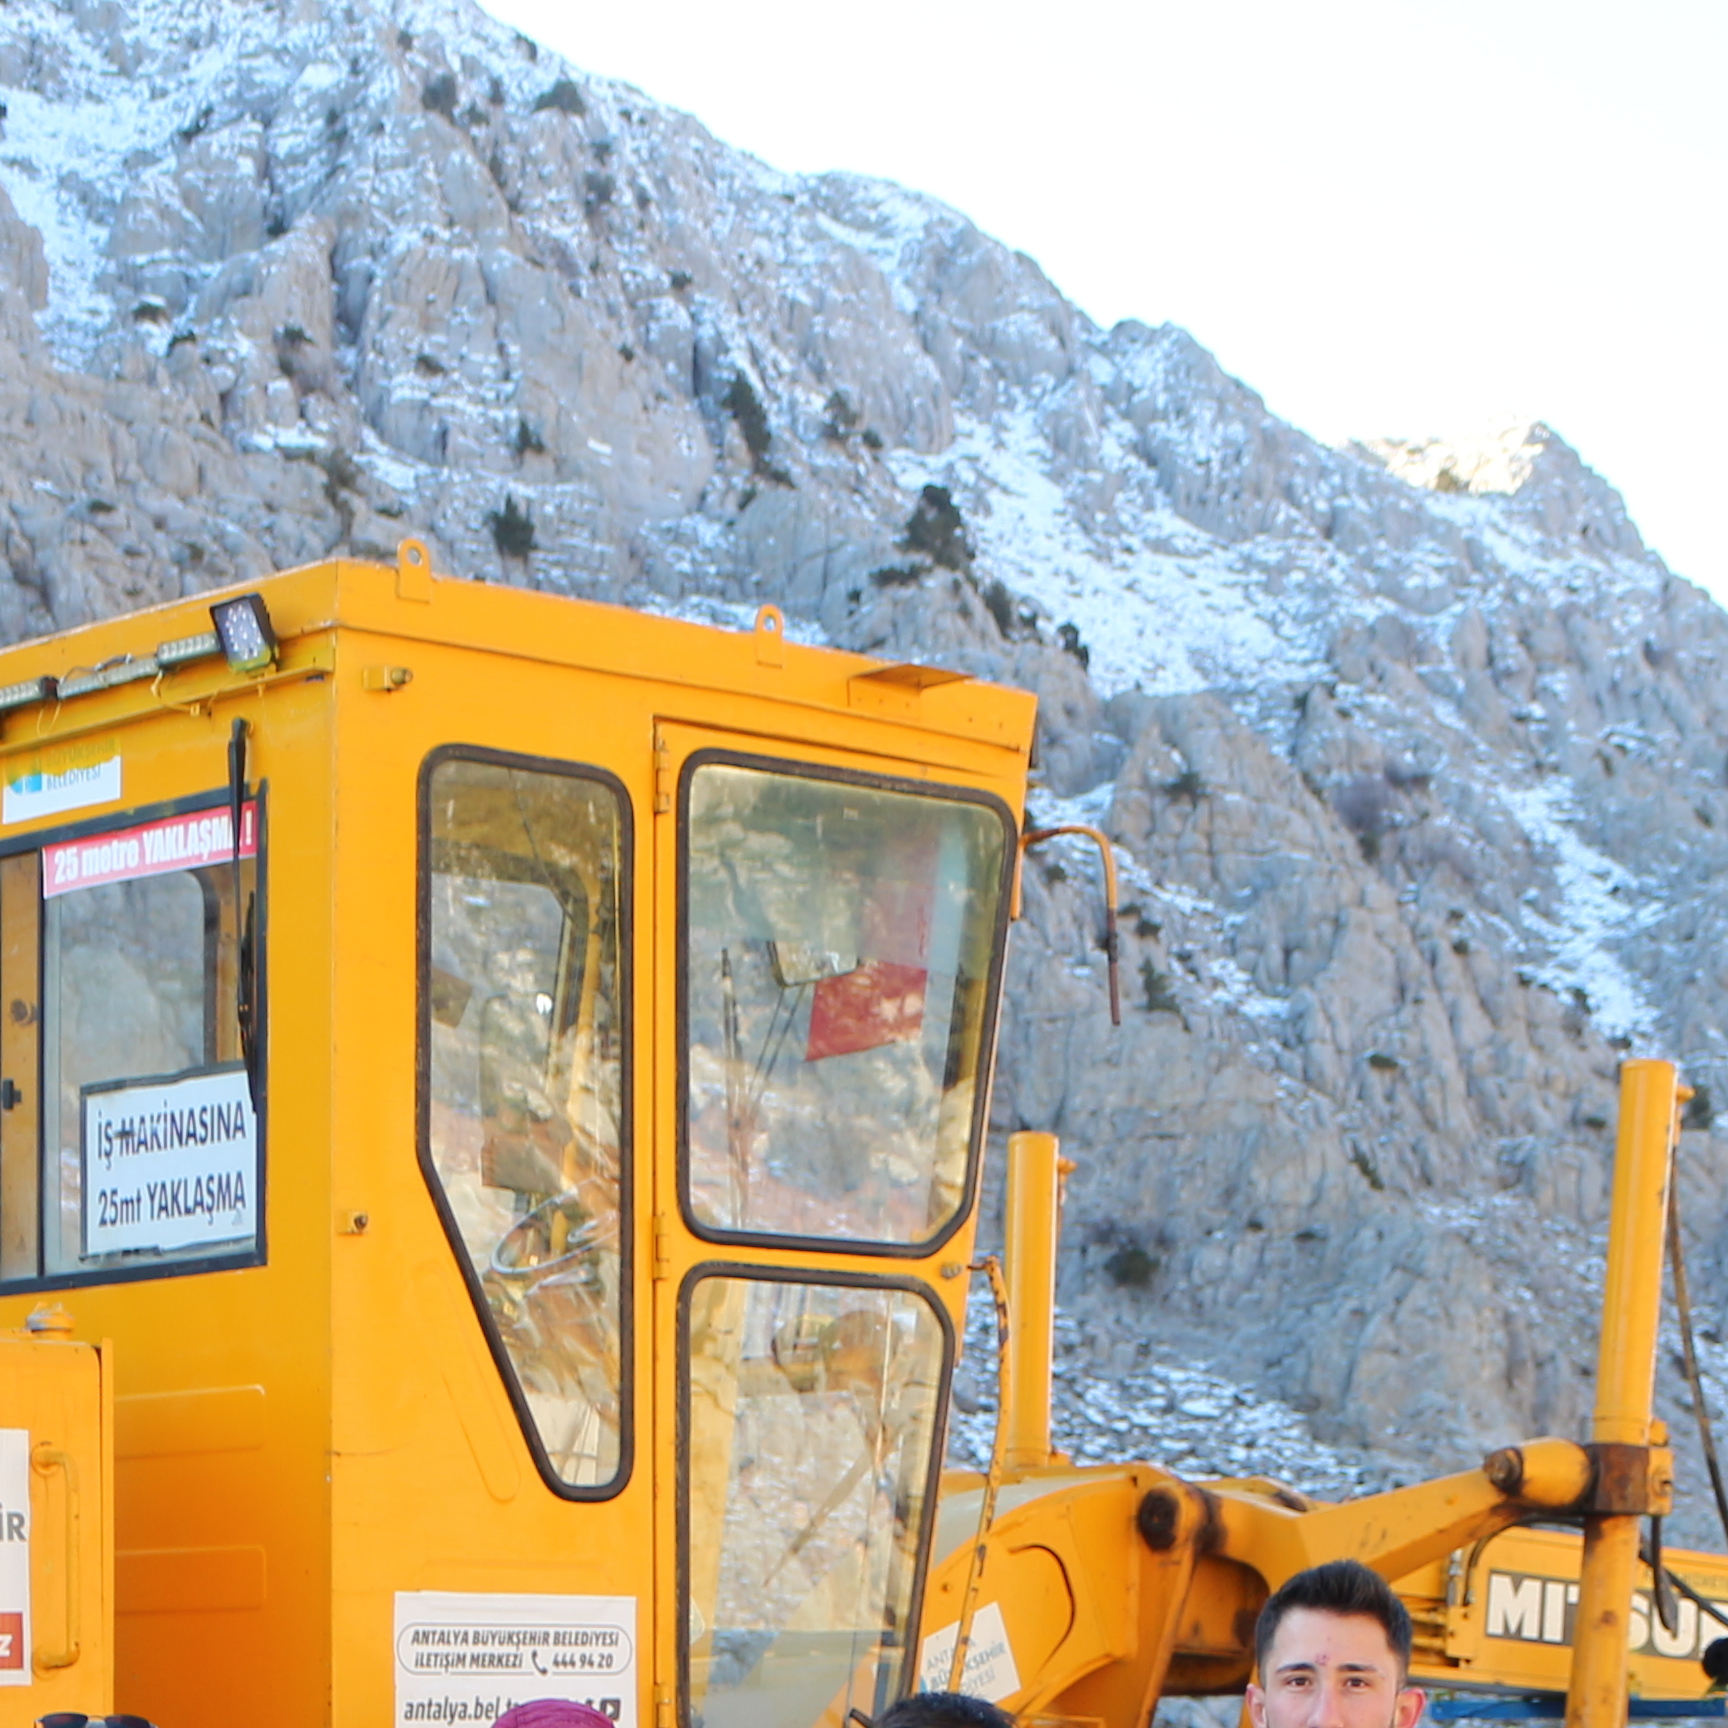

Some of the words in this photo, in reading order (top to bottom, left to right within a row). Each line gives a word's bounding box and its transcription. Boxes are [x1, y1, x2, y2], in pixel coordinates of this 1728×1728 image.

[54, 846, 79, 885] 25
[82, 836, 139, 878] metre
[97, 1110, 114, 1170] İŞ
[119, 1099, 246, 1158] MAKİNASINA
[98, 1187, 142, 1227] 25mt
[146, 1170, 247, 1227] YAKLAŞMA
[410, 1629, 470, 1647] ANTALYA
[472, 1629, 550, 1651] BÜYÜKŞEHİR
[553, 1631, 620, 1648] BELEDİYESİ
[414, 1651, 467, 1674] İLETİŞİM
[469, 1652, 523, 1669] MERKEZİ
[552, 1652, 577, 1669] 444
[579, 1653, 595, 1669] 94
[597, 1653, 614, 1669] 20
